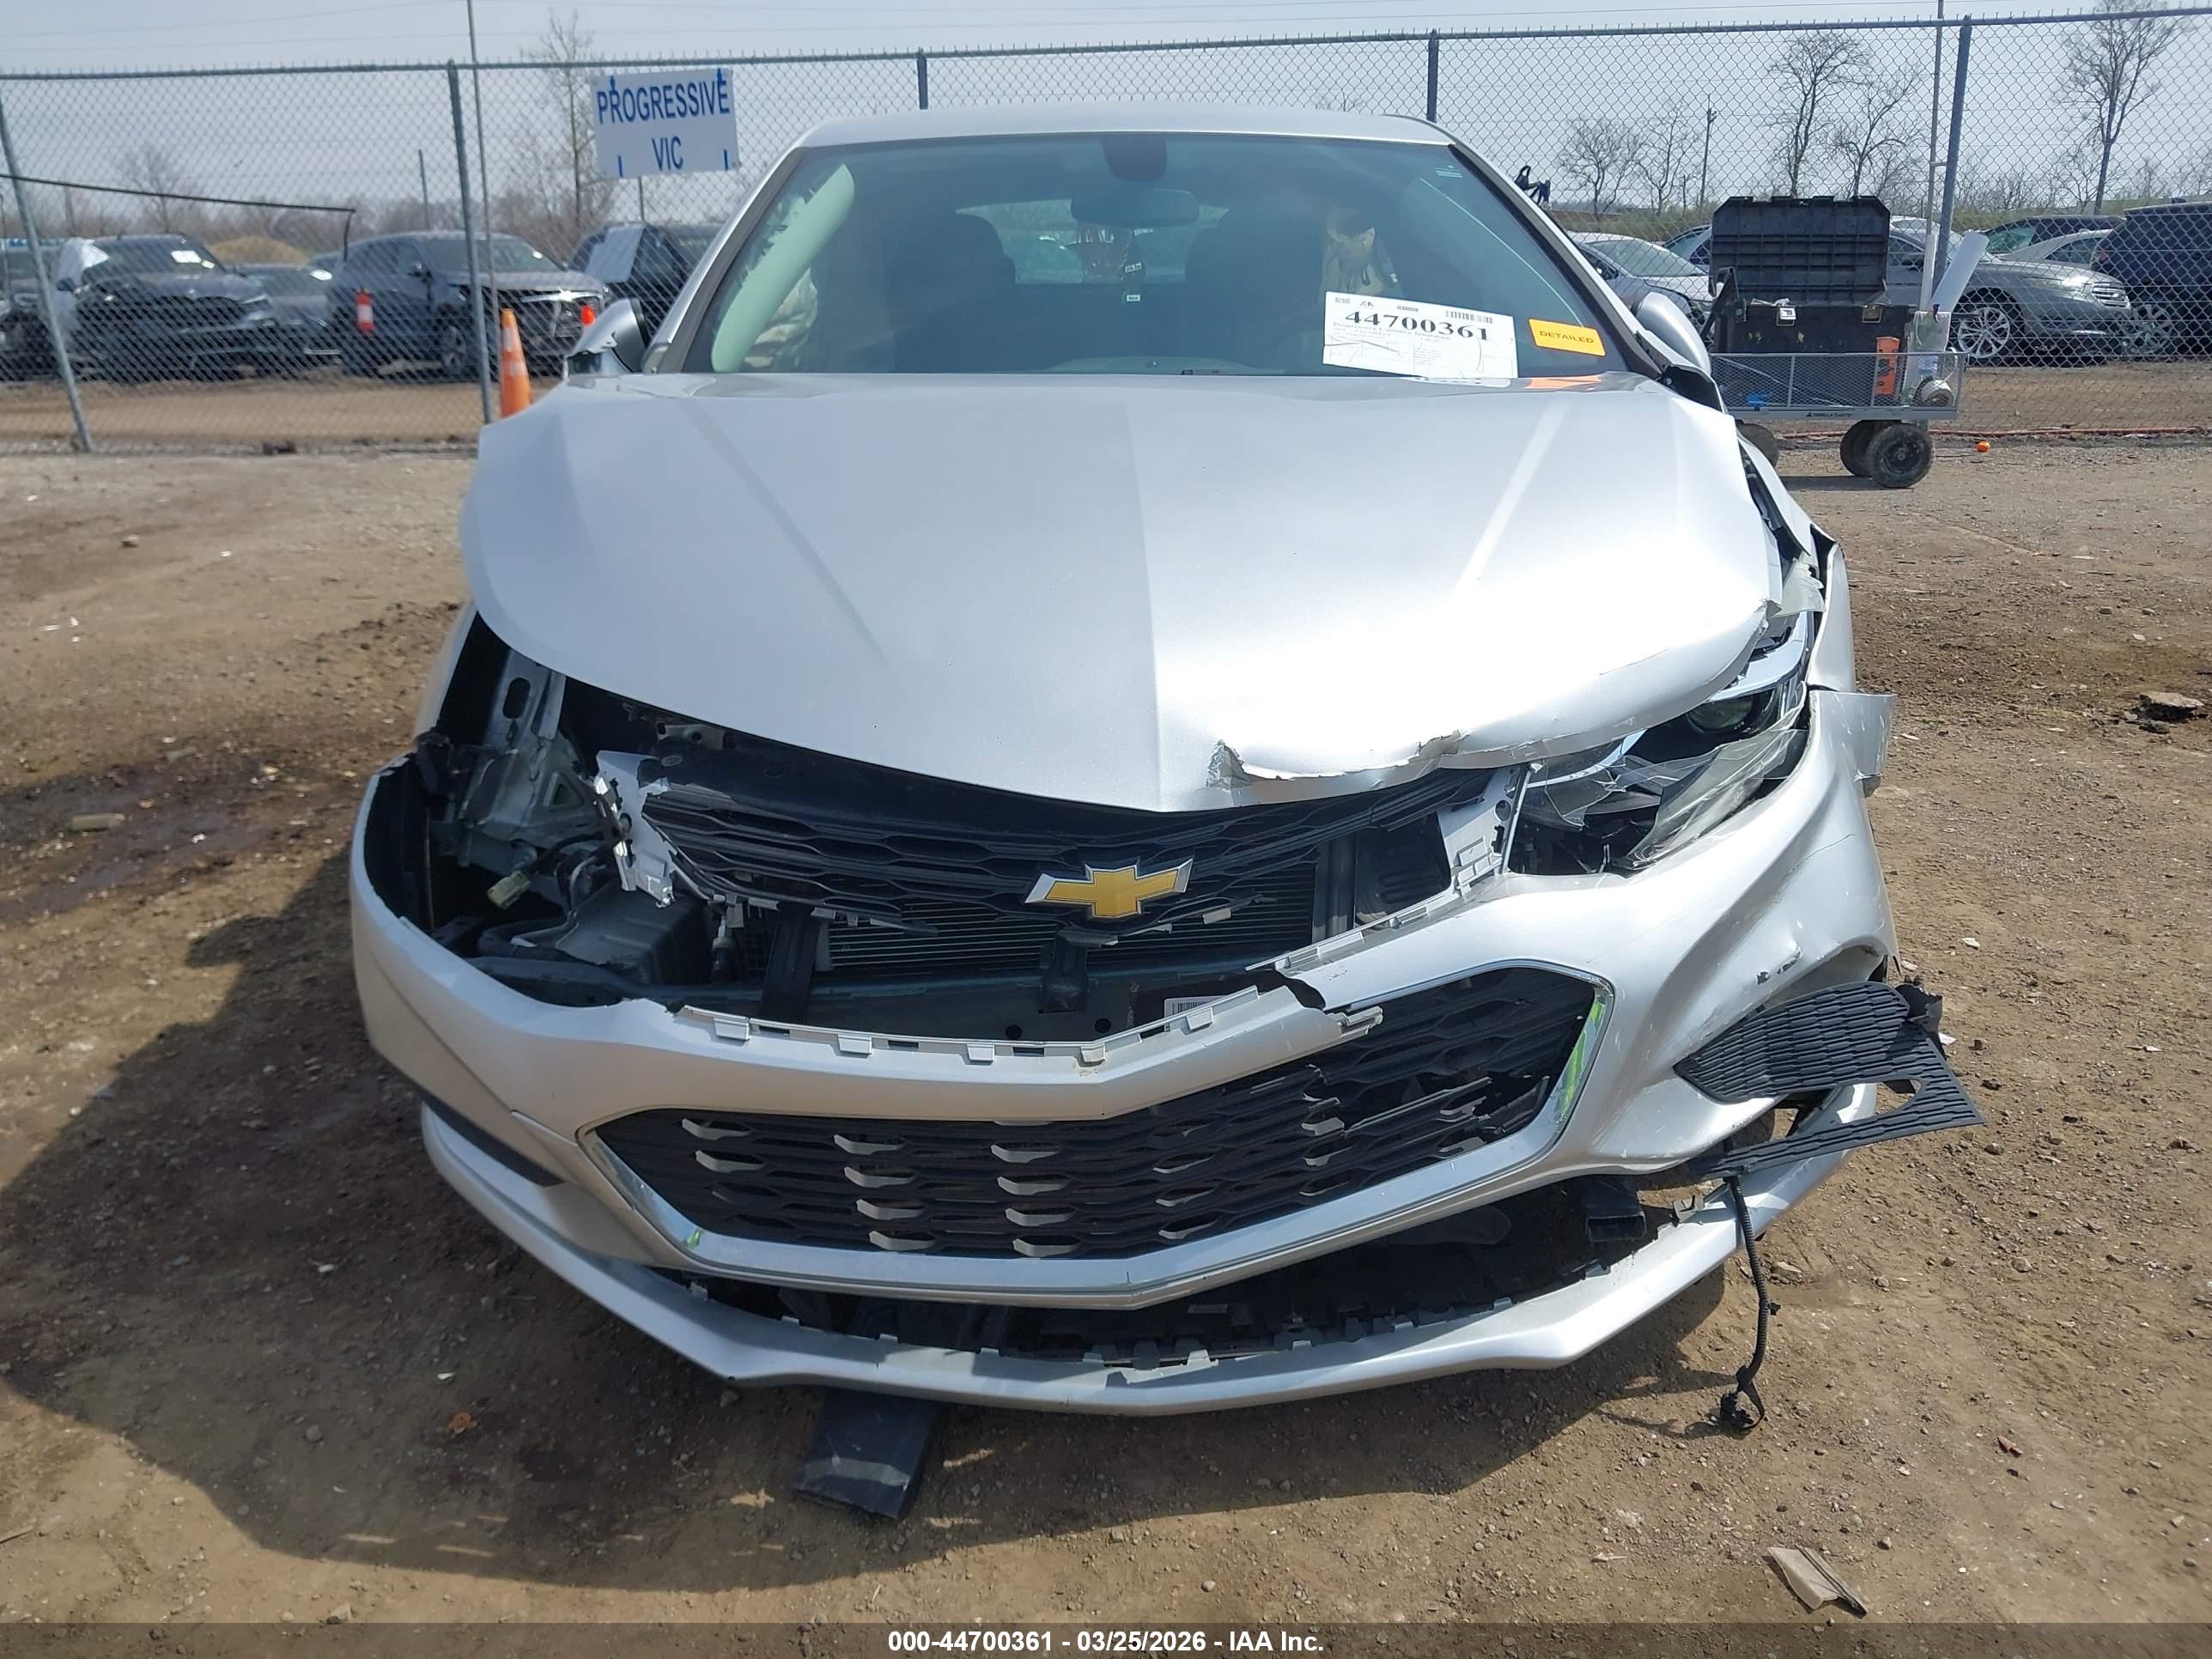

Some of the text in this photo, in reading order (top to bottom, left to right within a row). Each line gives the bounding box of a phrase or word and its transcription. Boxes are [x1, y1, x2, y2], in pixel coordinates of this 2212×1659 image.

[597, 80, 730, 125] PROGRESSIVE
[652, 136, 684, 172] VIC
[1345, 311, 1488, 341] 44700361
[1540, 331, 1595, 343] DETAILED
